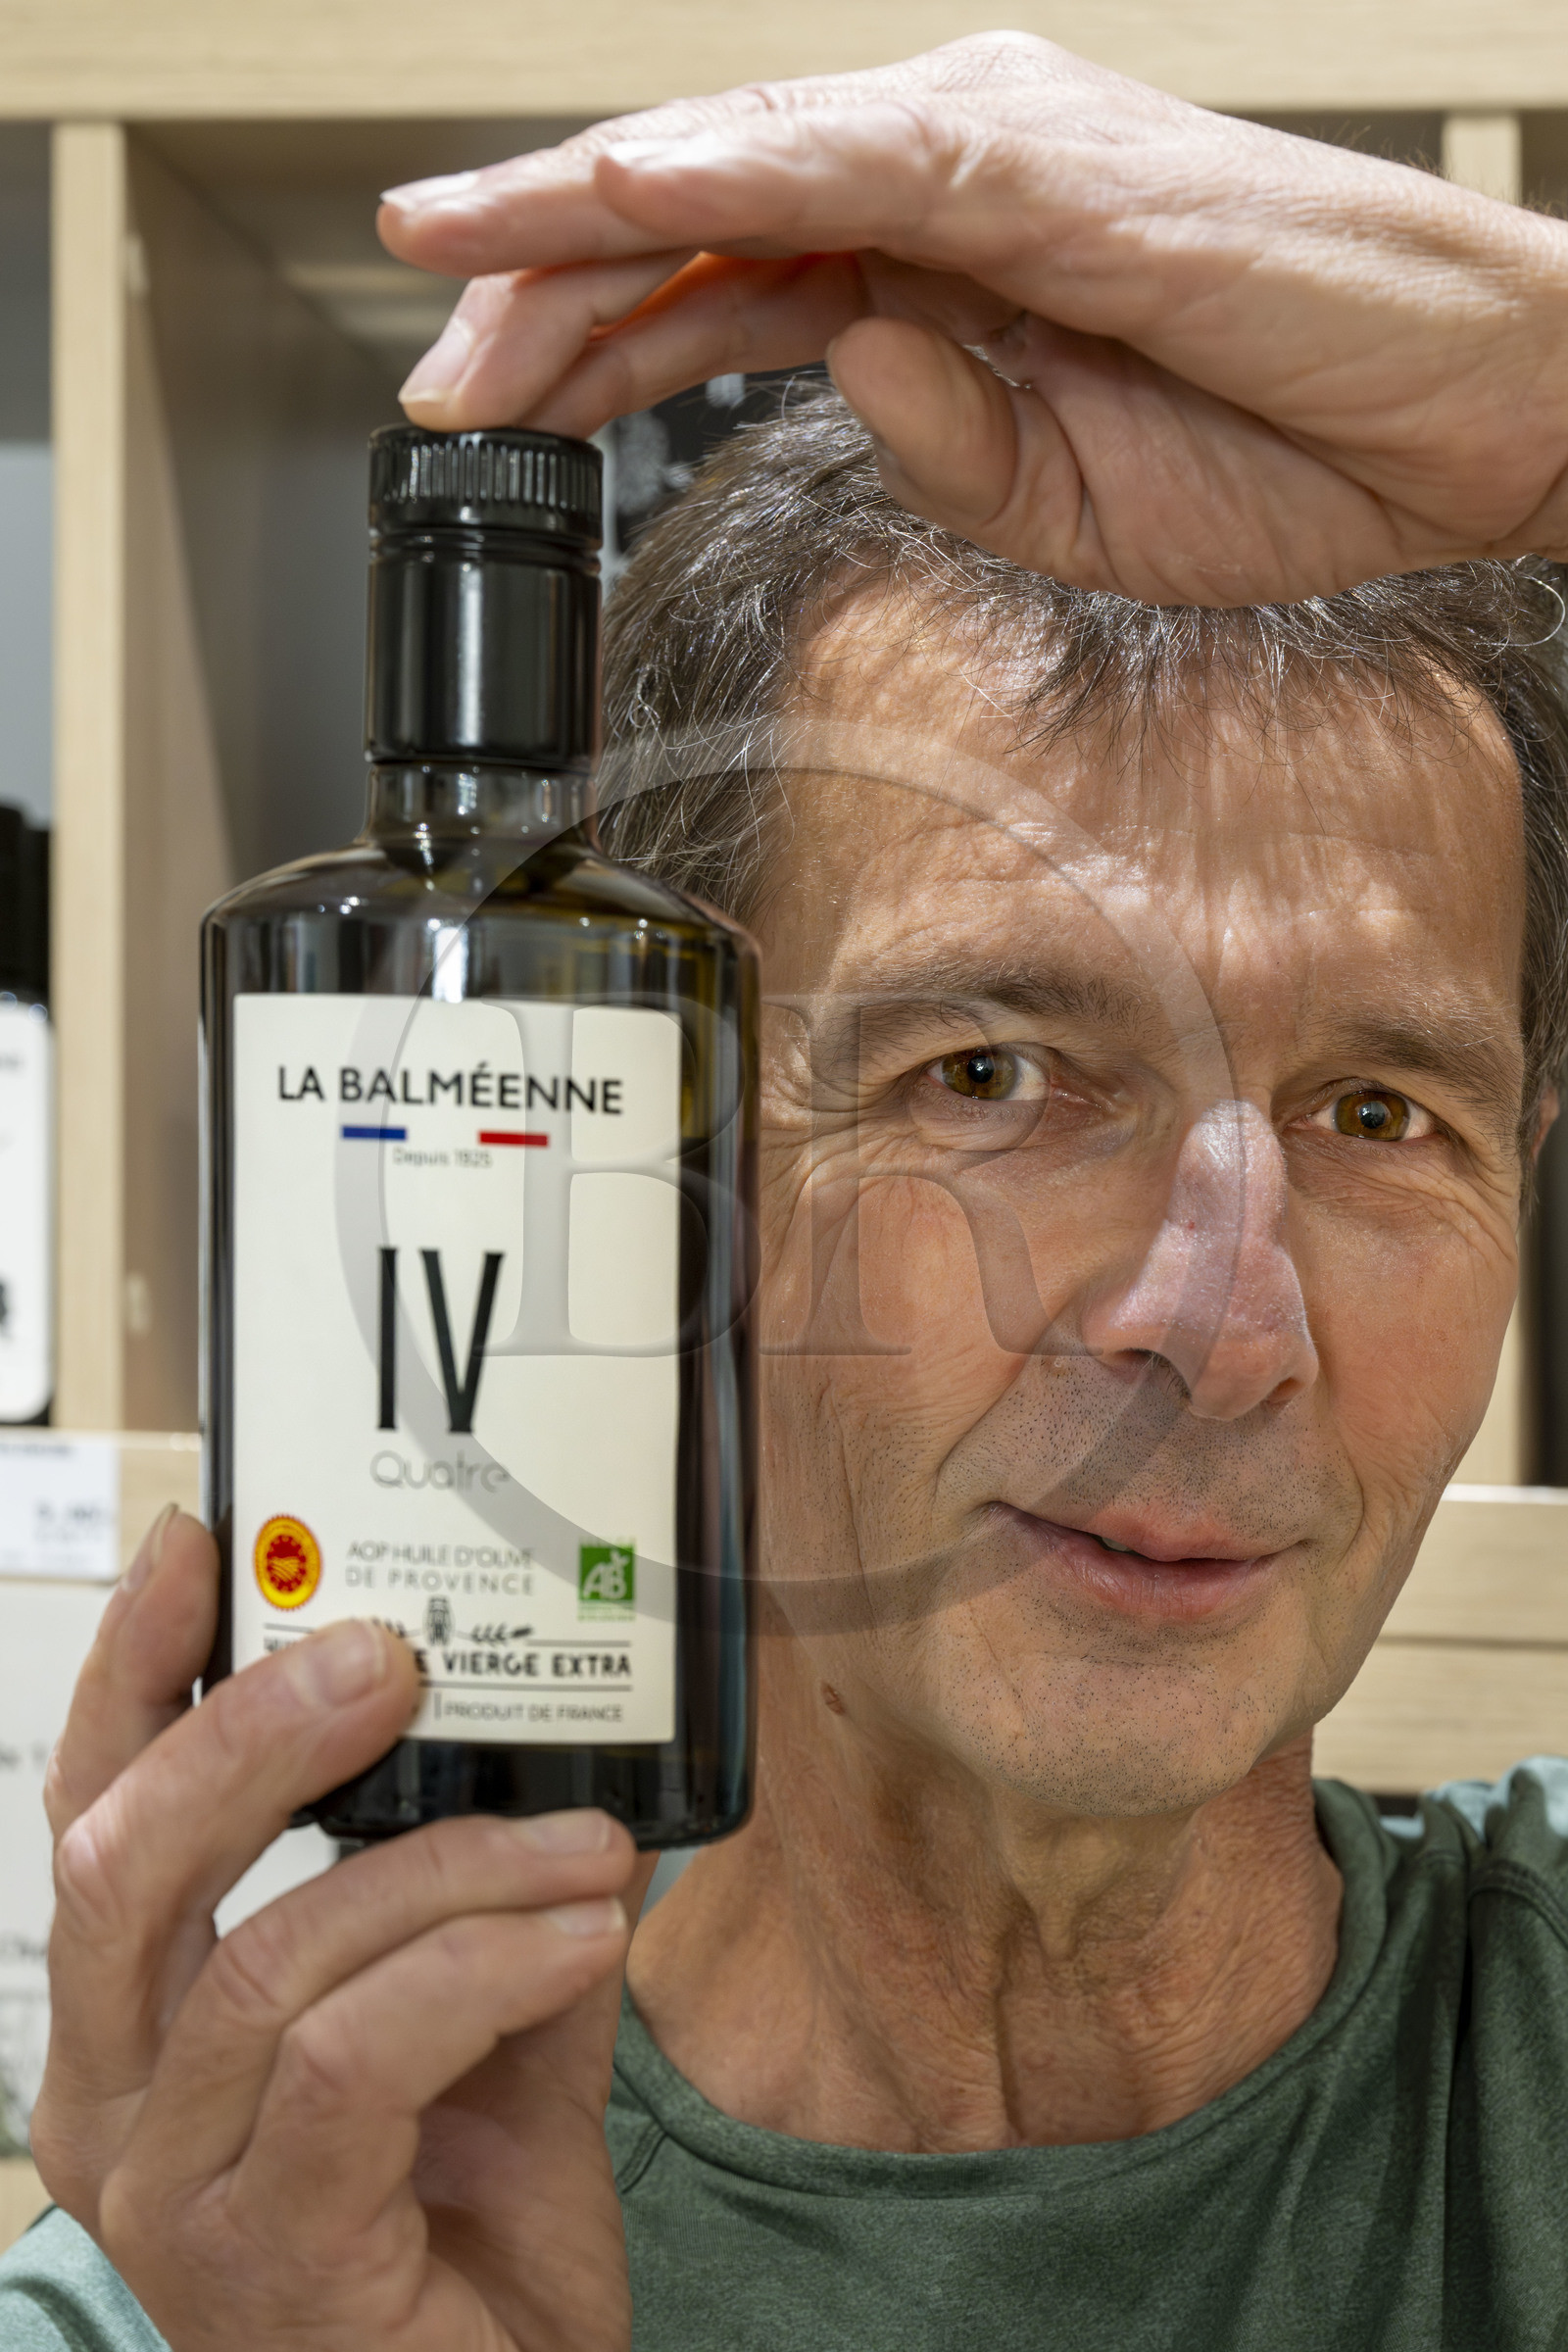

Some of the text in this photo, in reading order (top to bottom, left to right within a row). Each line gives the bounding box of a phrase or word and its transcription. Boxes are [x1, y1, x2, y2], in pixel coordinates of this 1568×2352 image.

[278, 1061, 624, 1115] LA BALMÉENNE
[392, 1146, 450, 1167] Depuis
[376, 1247, 506, 1435] IV
[369, 1449, 510, 1492] Quatre
[391, 1544, 451, 1565] HUILE
[344, 1565, 534, 1595] DE PROVENCE
[442, 1651, 539, 1677] VIERGE
[551, 1653, 632, 1678] EXTRA
[444, 1700, 623, 1723] PRODUIT DE FRANCE
